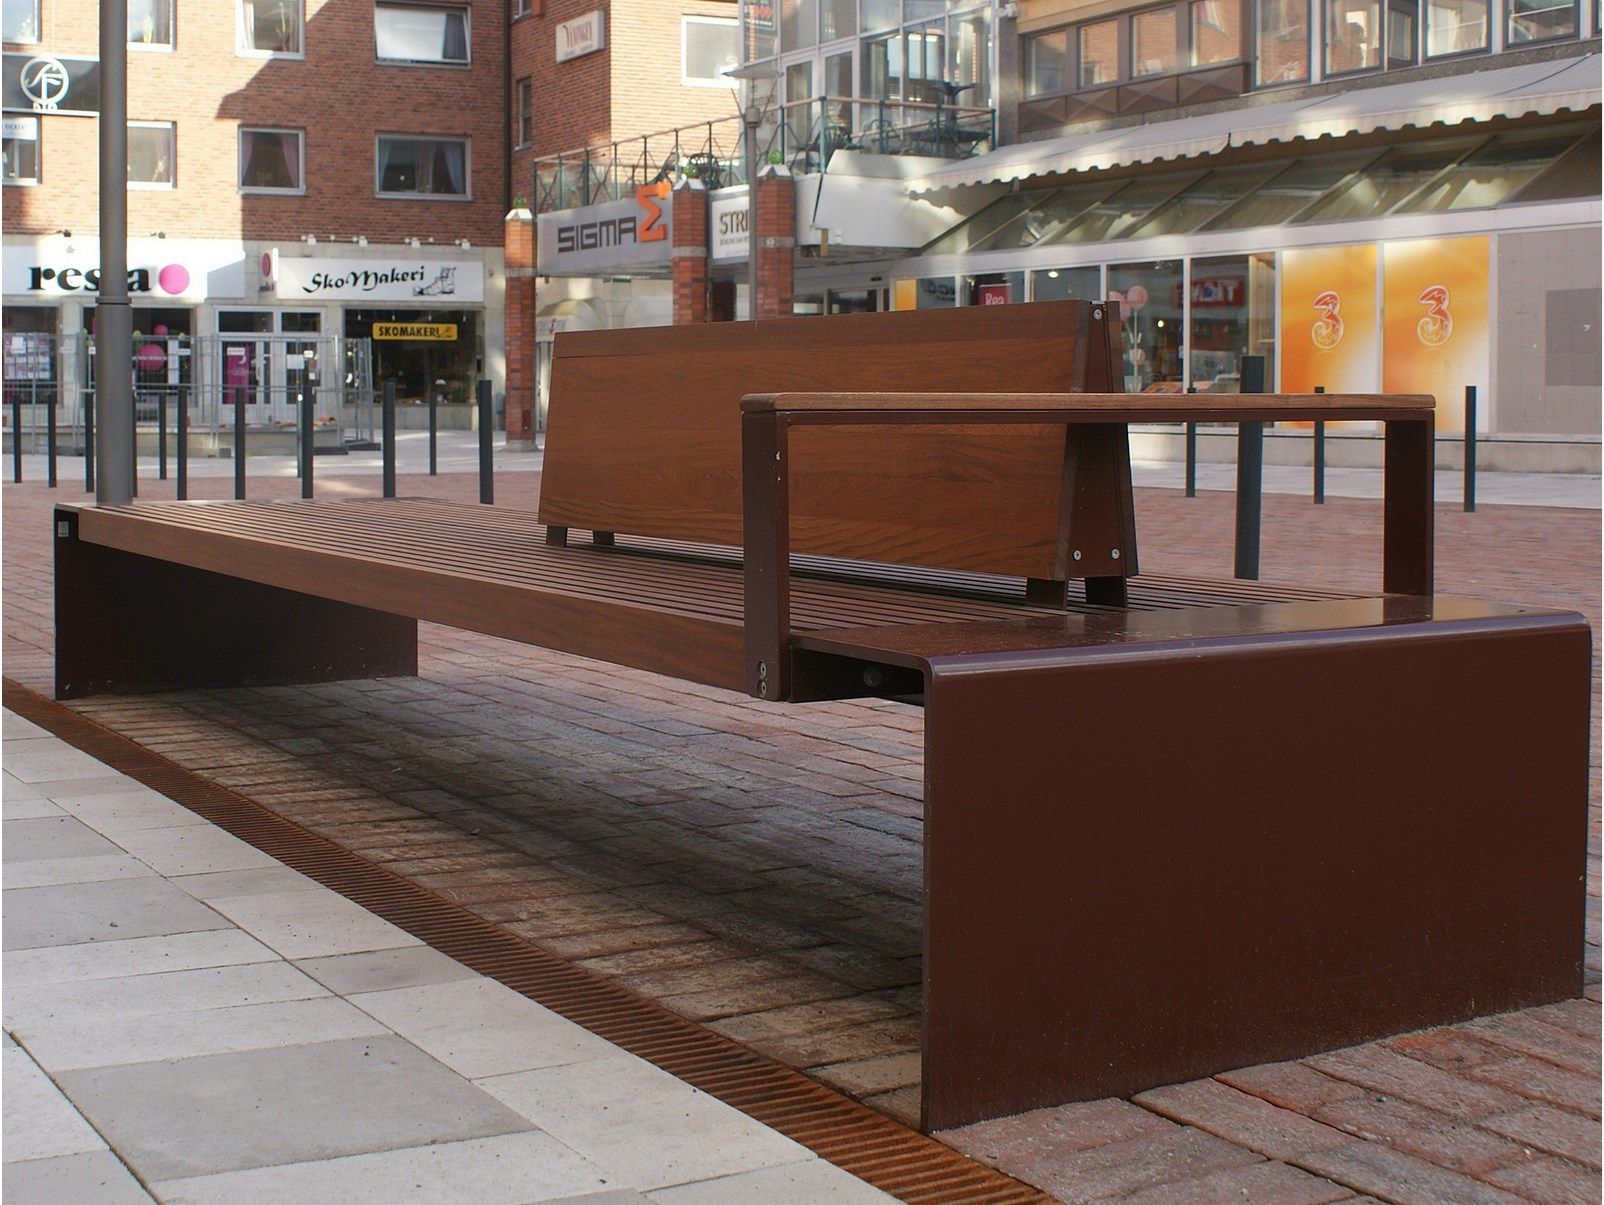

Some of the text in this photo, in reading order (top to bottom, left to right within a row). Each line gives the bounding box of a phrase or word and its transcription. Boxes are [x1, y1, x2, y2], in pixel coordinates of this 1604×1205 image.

[557, 216, 637, 253] SIGMA
[27, 266, 152, 292] resa
[302, 265, 426, 293] SkoMakeri
